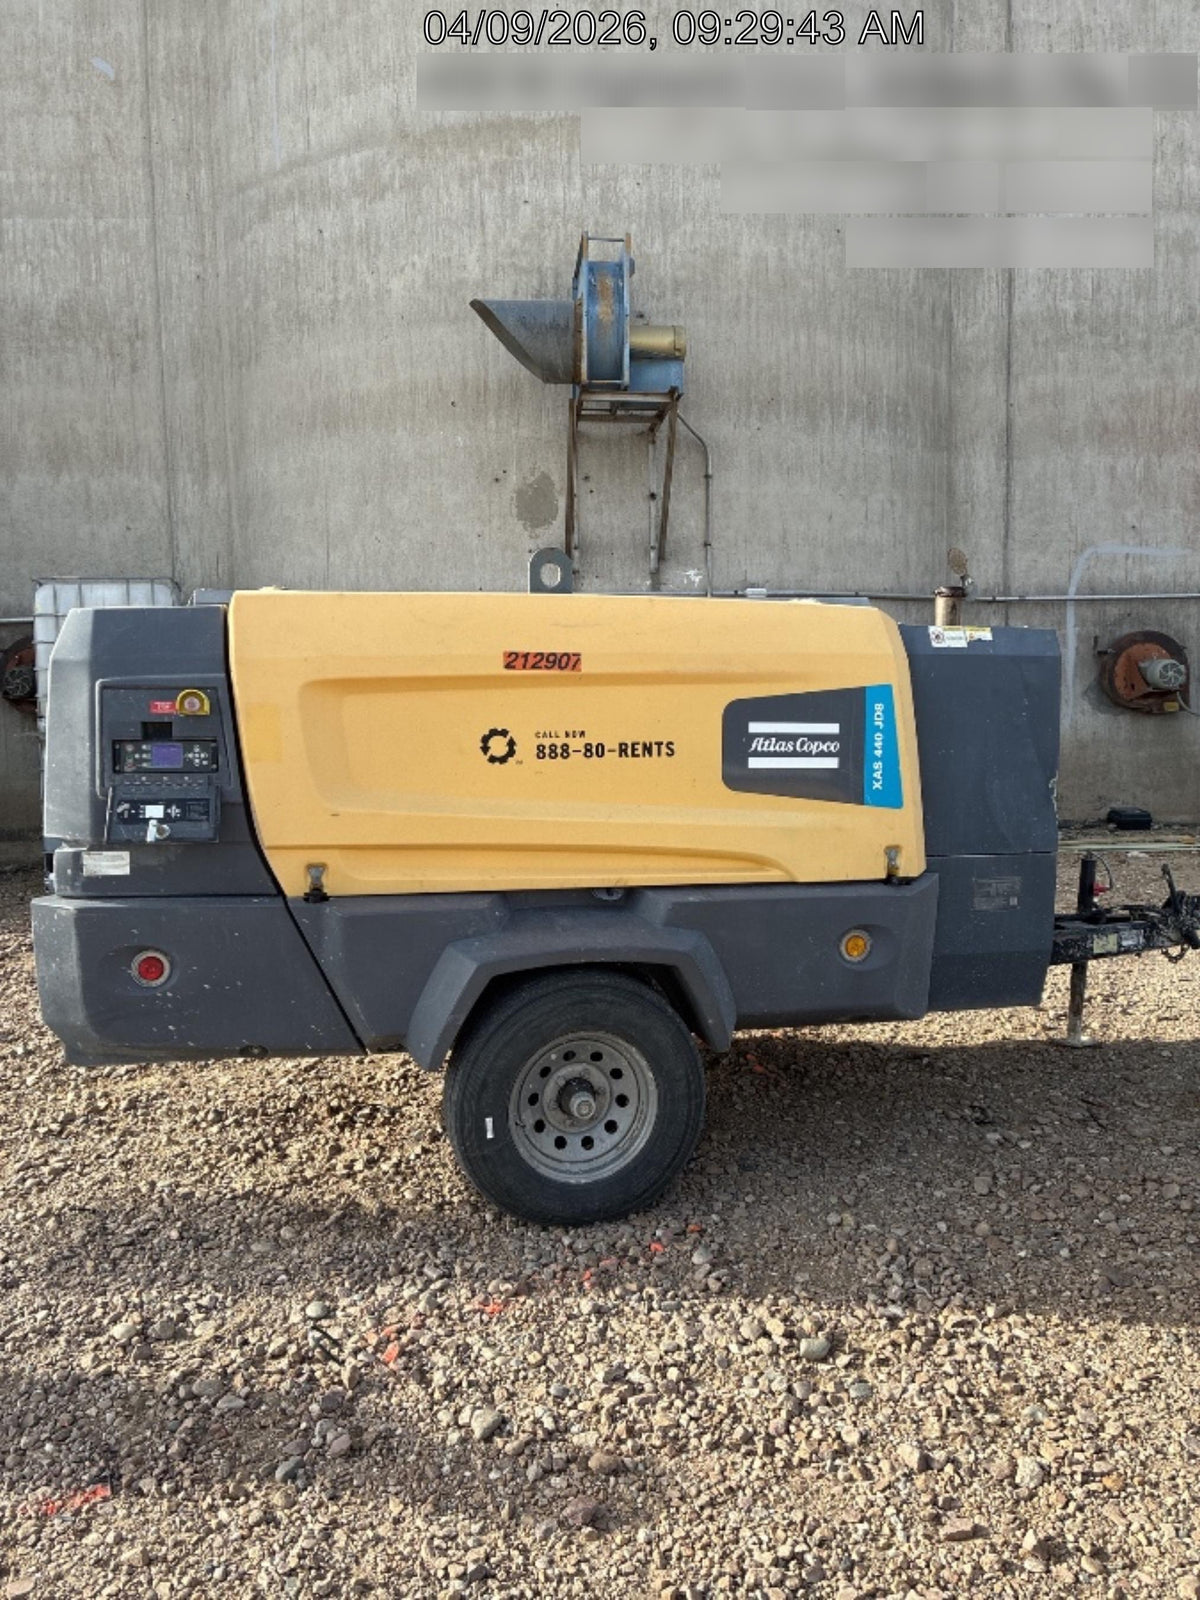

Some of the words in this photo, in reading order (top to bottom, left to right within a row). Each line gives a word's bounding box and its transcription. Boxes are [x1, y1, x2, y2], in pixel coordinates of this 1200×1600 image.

[504, 651, 581, 671] 212907
[874, 703, 884, 729] JD8
[535, 731, 560, 739] CALL
[565, 730, 586, 738] NOW
[536, 741, 675, 760] 888-80-RENTS
[749, 737, 794, 752] Atlas
[796, 737, 840, 755] Copco
[874, 734, 883, 758] 440
[872, 761, 883, 790] XAS
